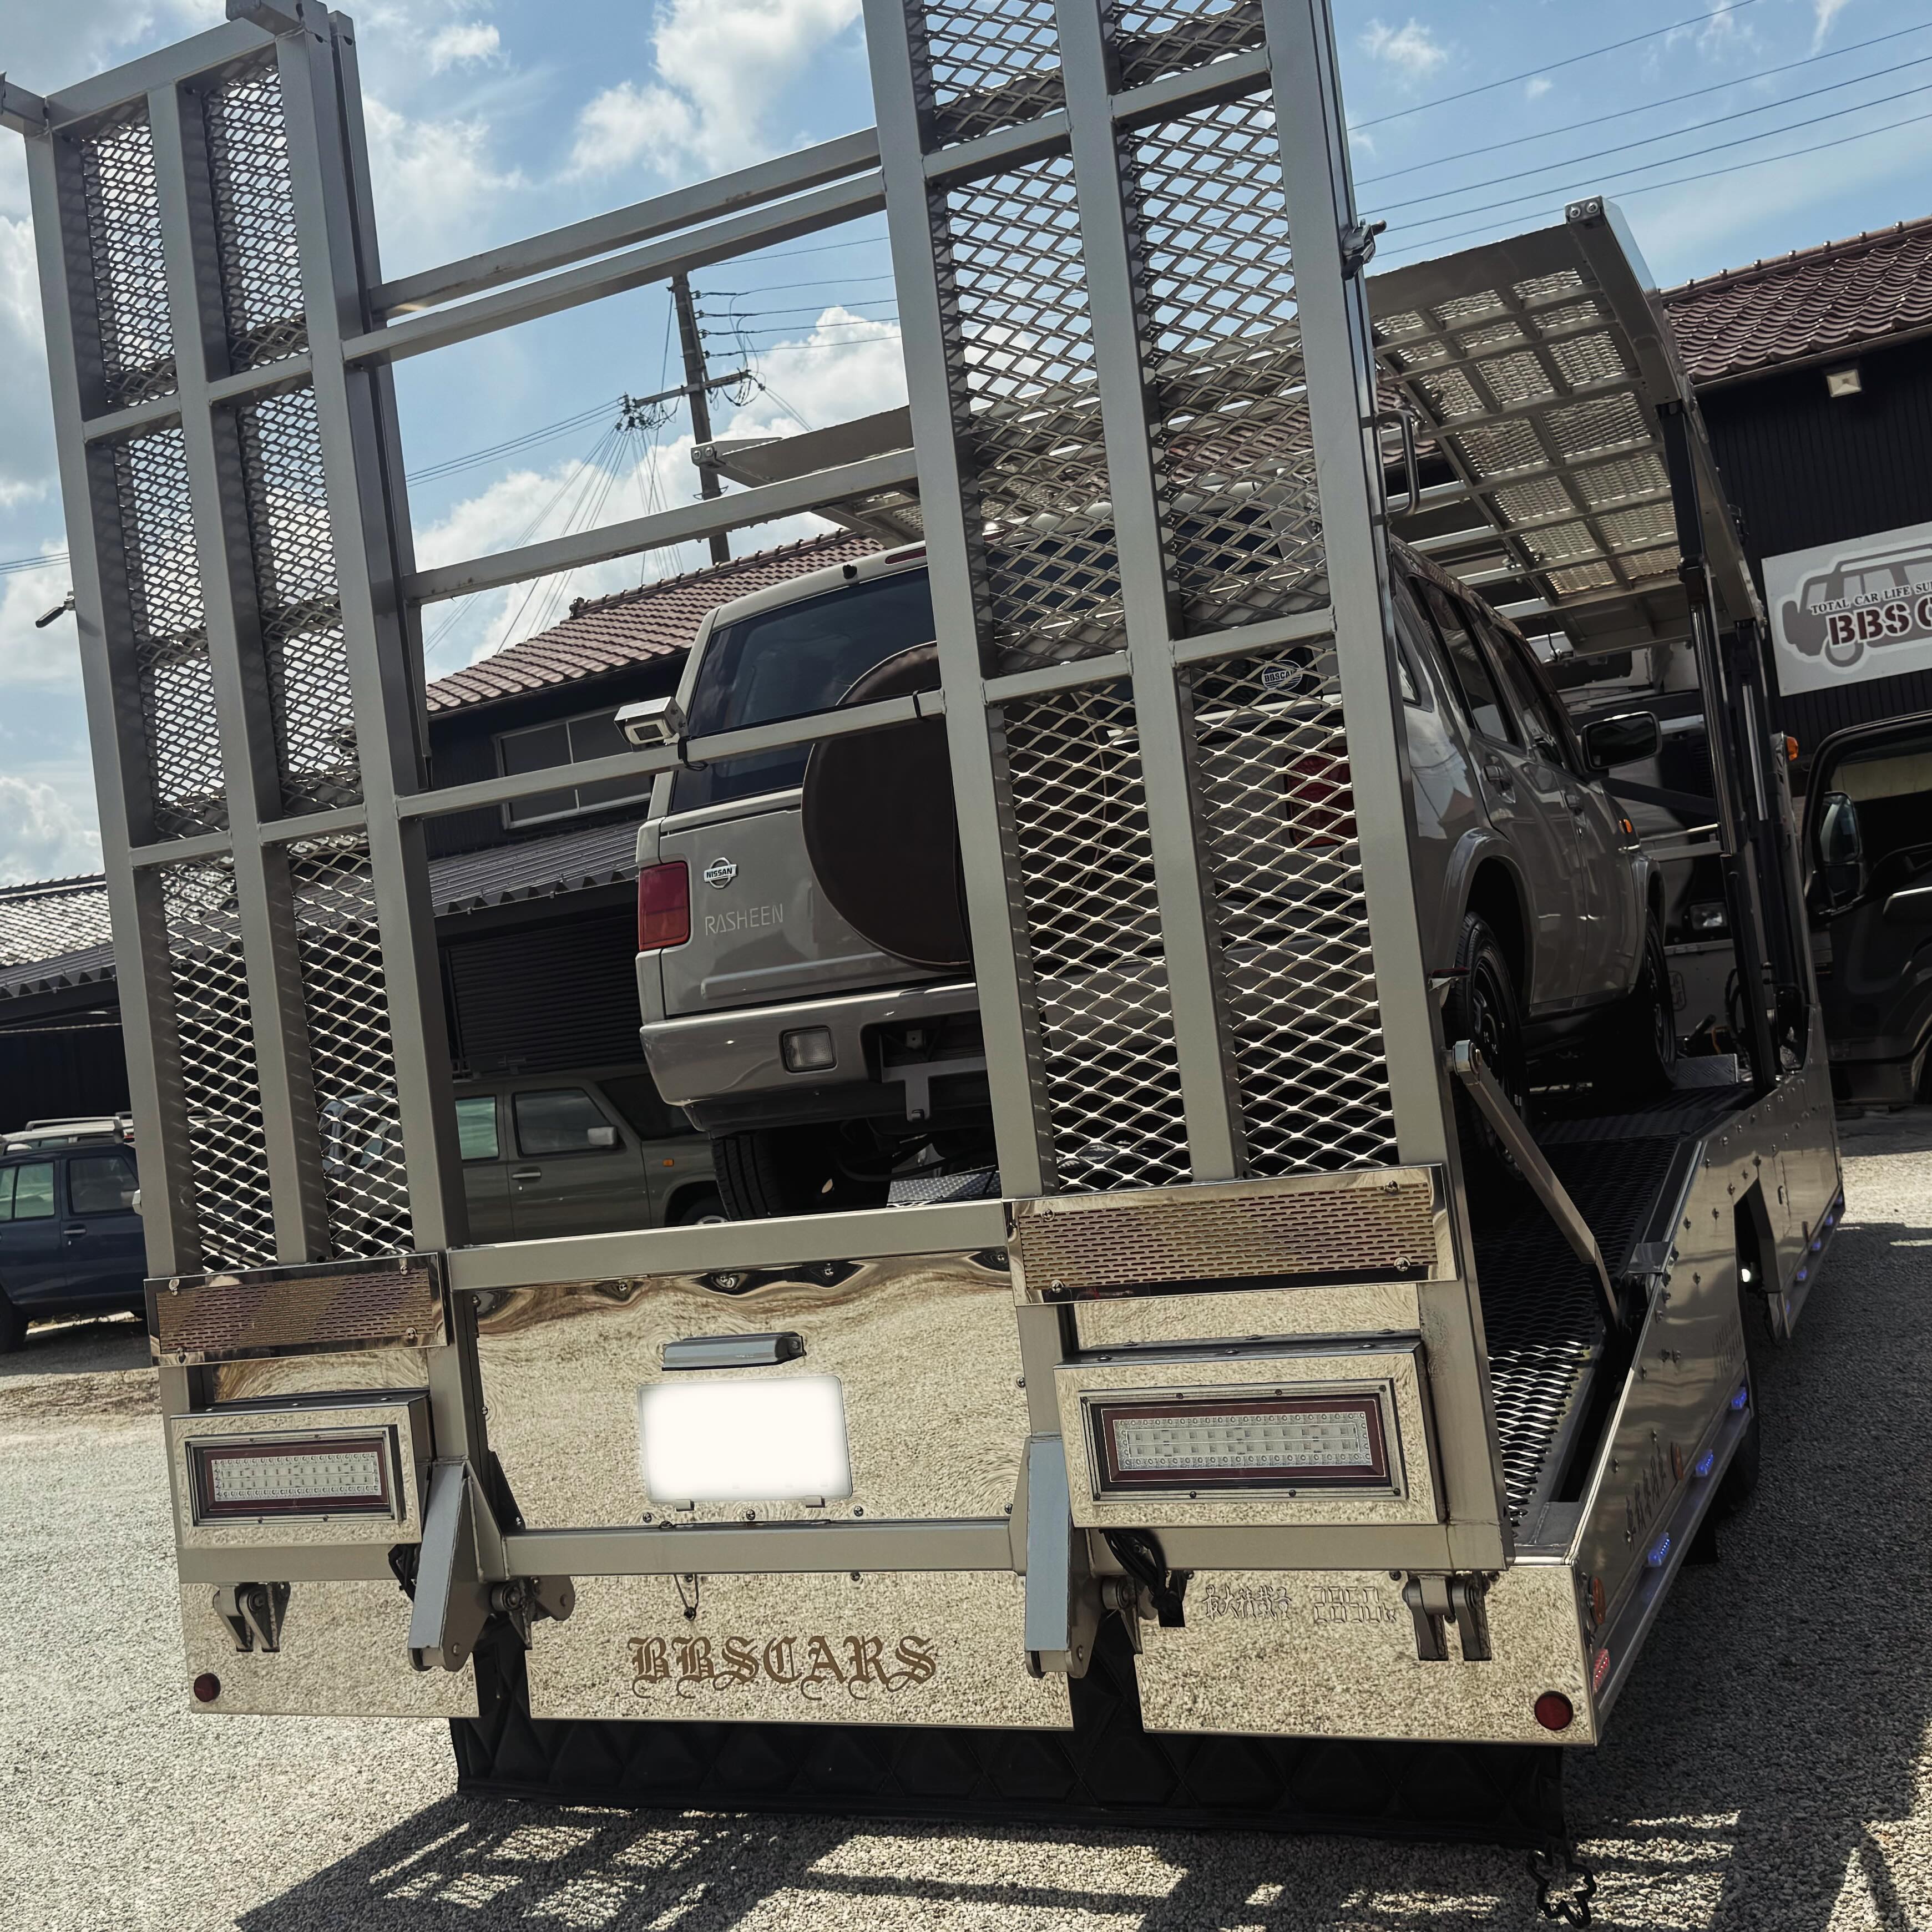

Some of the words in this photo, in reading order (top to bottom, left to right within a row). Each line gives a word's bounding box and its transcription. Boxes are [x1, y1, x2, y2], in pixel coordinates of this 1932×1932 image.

[1811, 599, 1849, 614] TOTAL
[1854, 593, 1879, 605] CAR
[1884, 586, 1910, 599] LIFE
[1915, 581, 1932, 593] SU
[1828, 603, 1910, 646] BBS
[706, 867, 732, 878] NISSAN
[705, 903, 783, 936] RASHEEN
[1202, 1584, 1292, 1621] 最大積載量
[627, 1635, 937, 1700] BBSCARS
